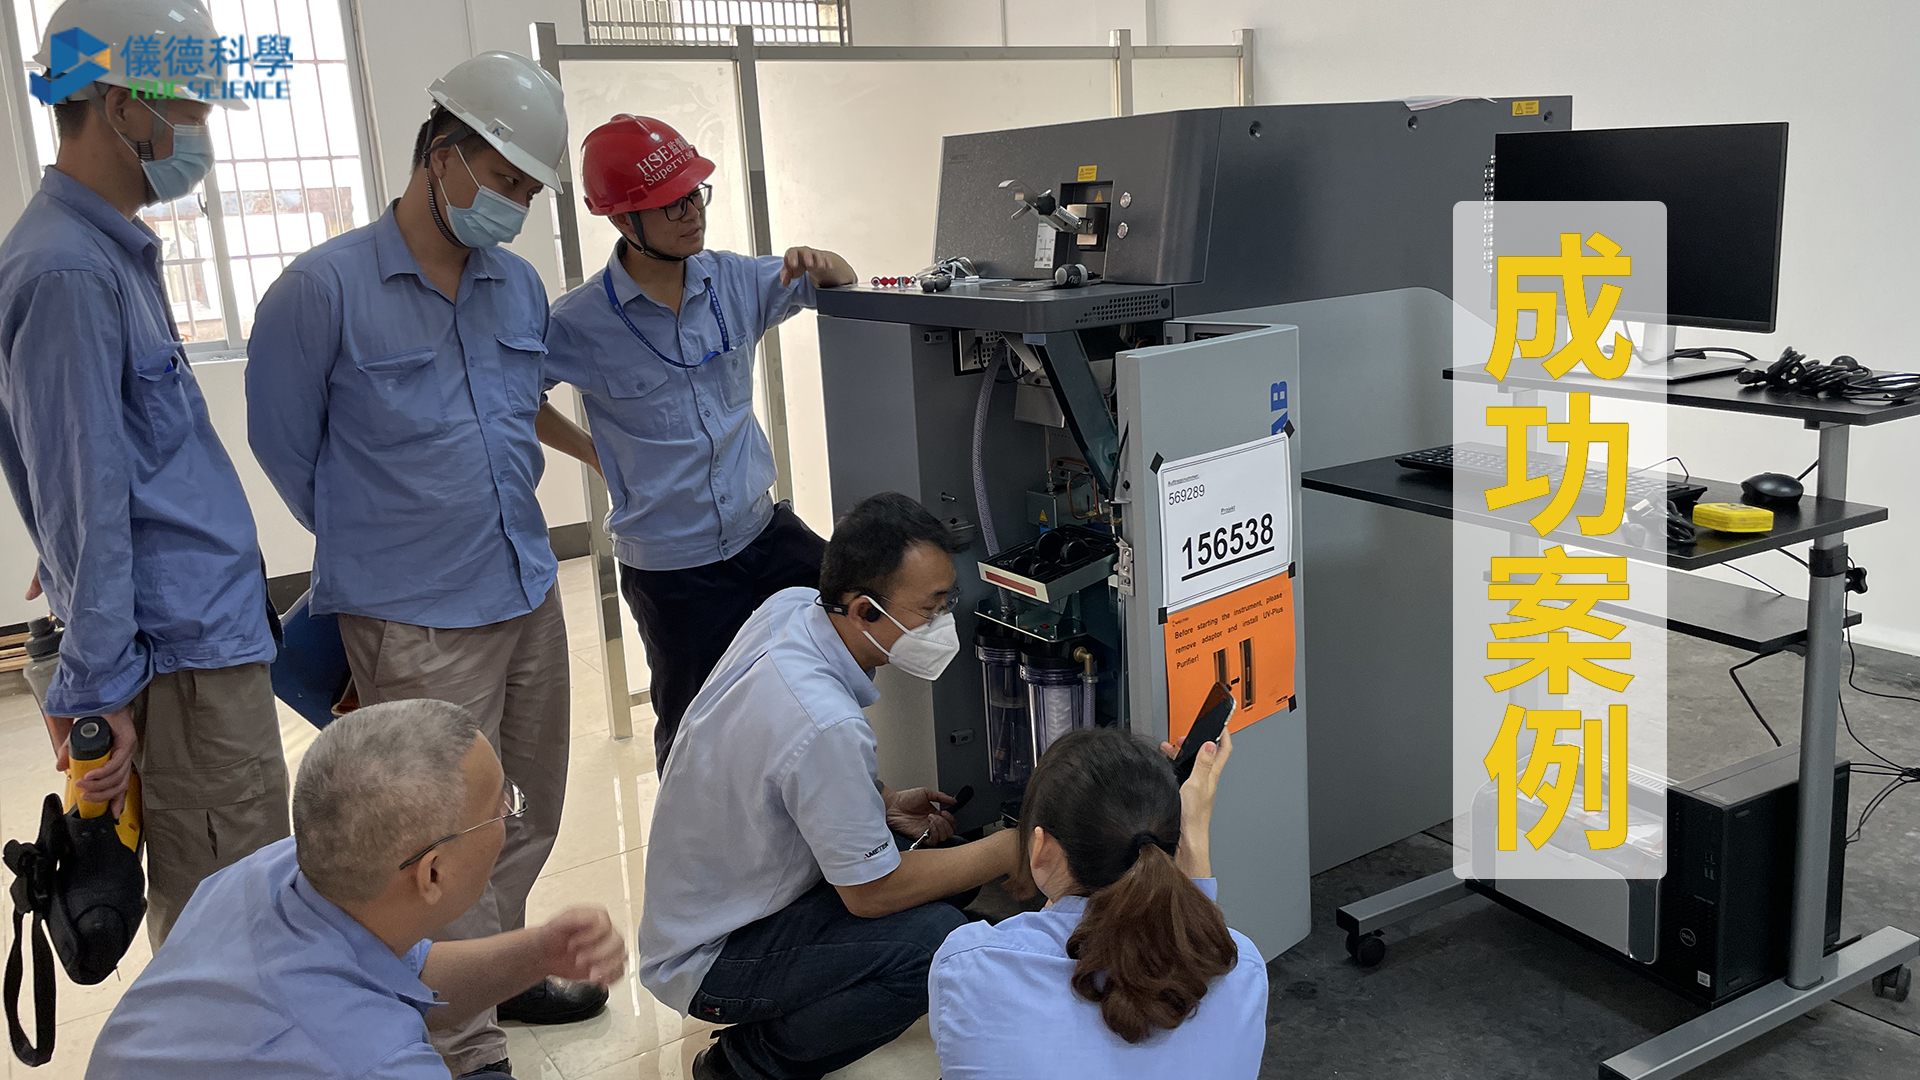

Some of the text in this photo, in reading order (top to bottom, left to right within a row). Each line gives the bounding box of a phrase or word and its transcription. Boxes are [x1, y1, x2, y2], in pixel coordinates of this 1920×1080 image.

[1168, 484, 1205, 505] 569289
[1181, 513, 1274, 570] 156538
[1174, 627, 1194, 640] Before
[1197, 617, 1218, 630] starting
[1221, 612, 1231, 621] the
[1265, 592, 1283, 604] please
[1175, 606, 1284, 655] remove adaptor and install UV-Plus
